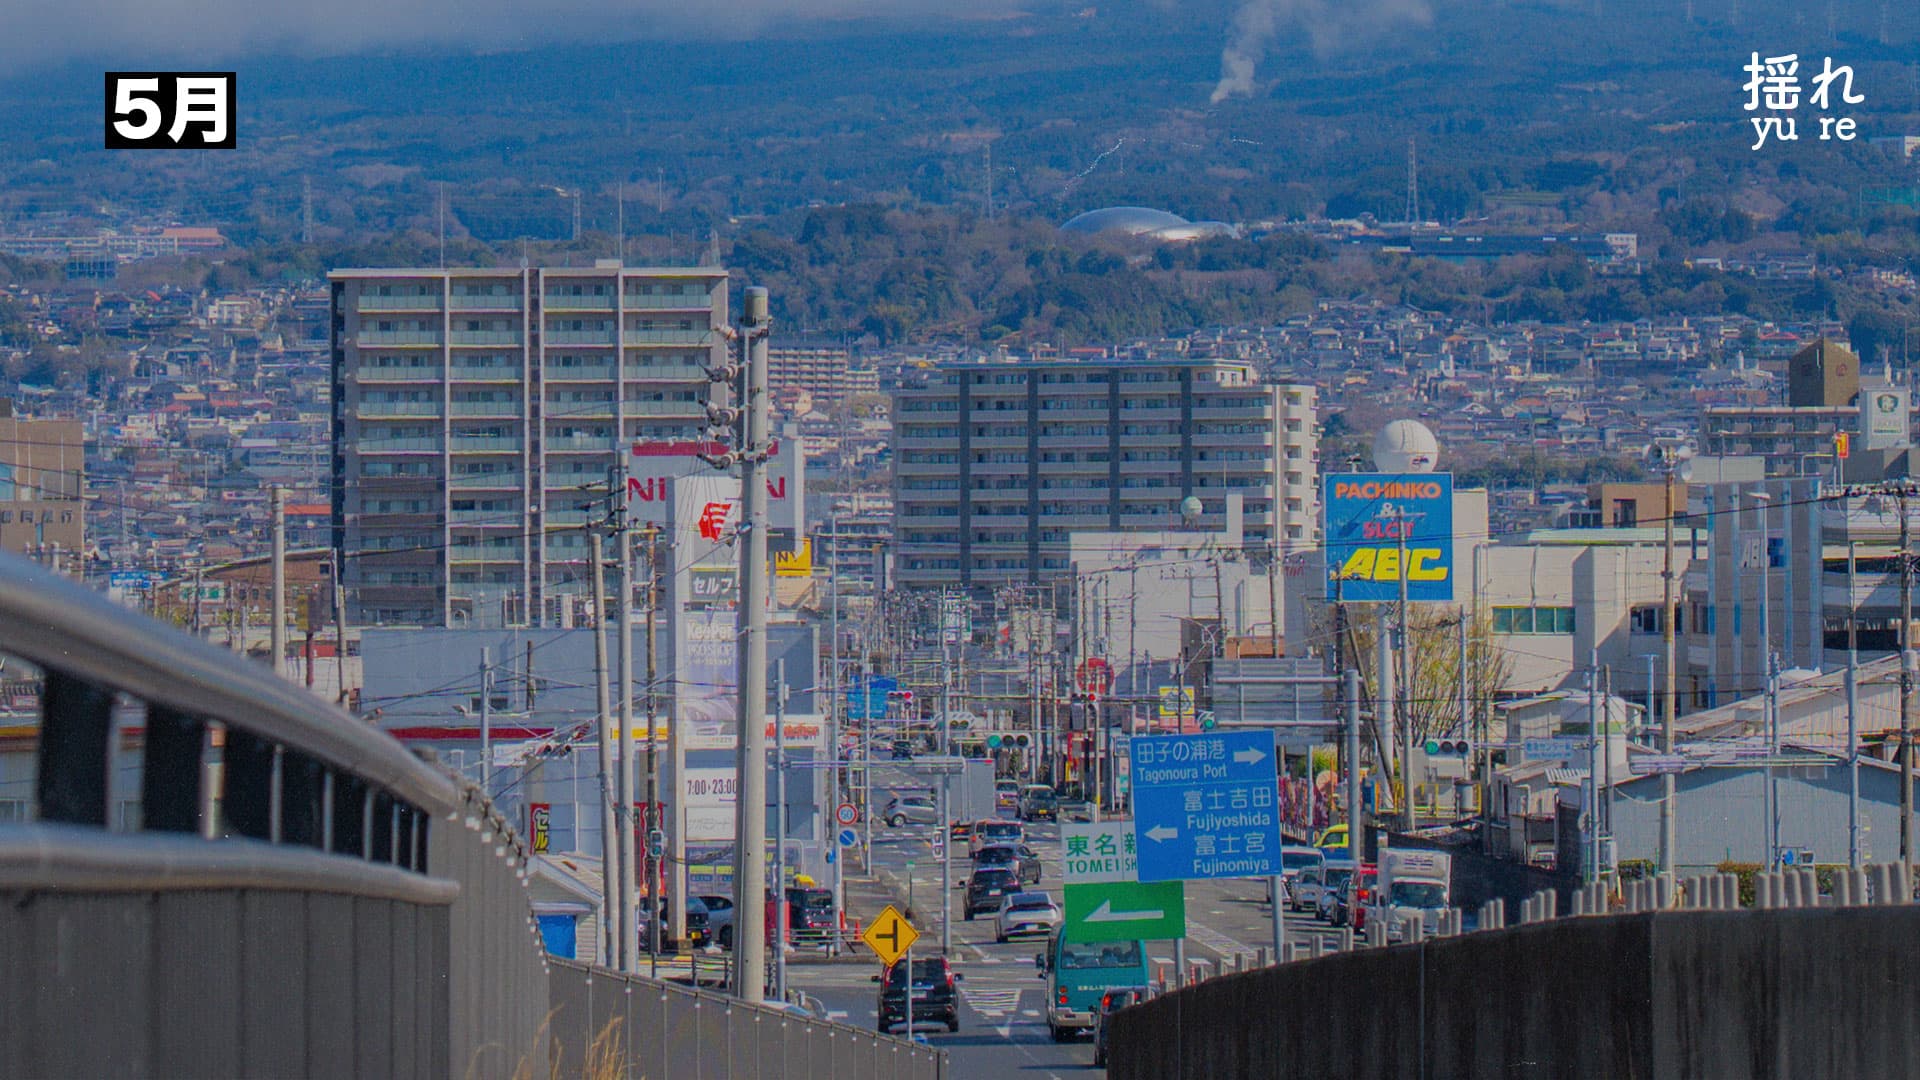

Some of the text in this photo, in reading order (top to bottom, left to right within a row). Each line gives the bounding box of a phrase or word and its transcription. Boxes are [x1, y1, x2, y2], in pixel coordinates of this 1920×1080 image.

[1335, 482, 1442, 499] PACHINKO
[1331, 547, 1448, 581] ABC
[693, 577, 733, 595] セルフ
[1137, 739, 1225, 764] 田子の浦港
[1138, 763, 1228, 784] Tagonoura Port
[1183, 786, 1272, 812] 富士吉田
[1187, 811, 1271, 832] Fujiyoshida
[1065, 833, 1117, 857] 東名
[1194, 832, 1266, 856] 富士宮
[1066, 859, 1120, 874] TOMEI
[1193, 857, 1270, 876] Fujinomiya
